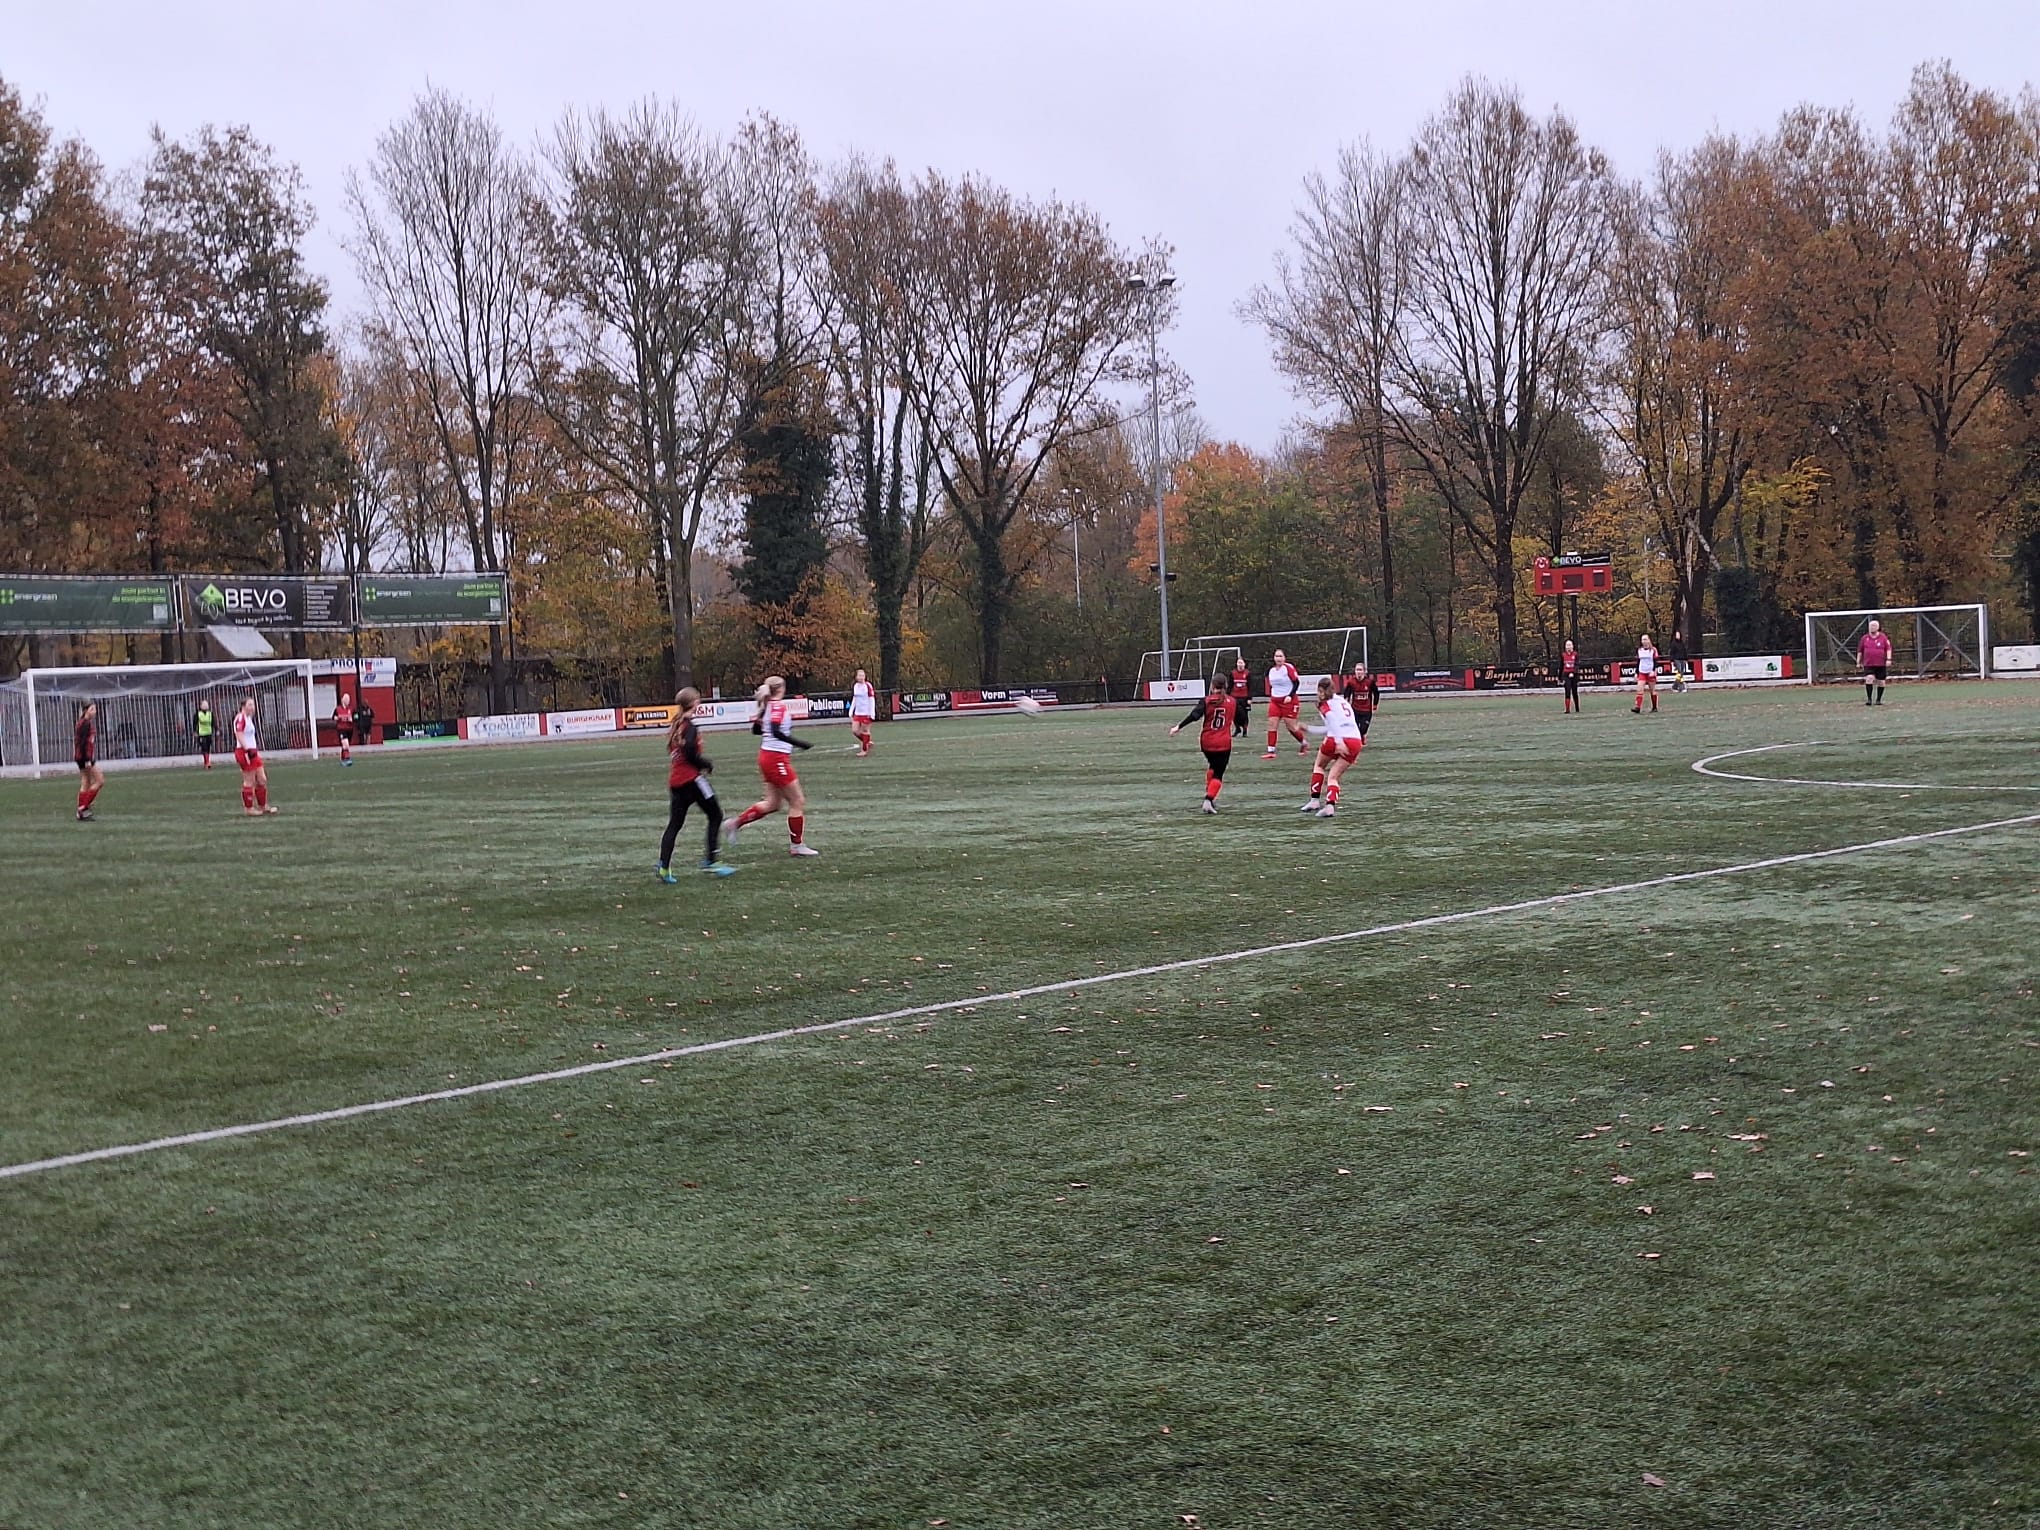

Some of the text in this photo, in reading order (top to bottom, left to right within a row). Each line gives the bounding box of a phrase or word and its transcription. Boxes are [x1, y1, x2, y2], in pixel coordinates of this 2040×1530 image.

[225, 588, 287, 609] BEVO
[982, 690, 1007, 700] Vorm
[1341, 702, 1352, 717] 5
[1211, 707, 1226, 731] 6
